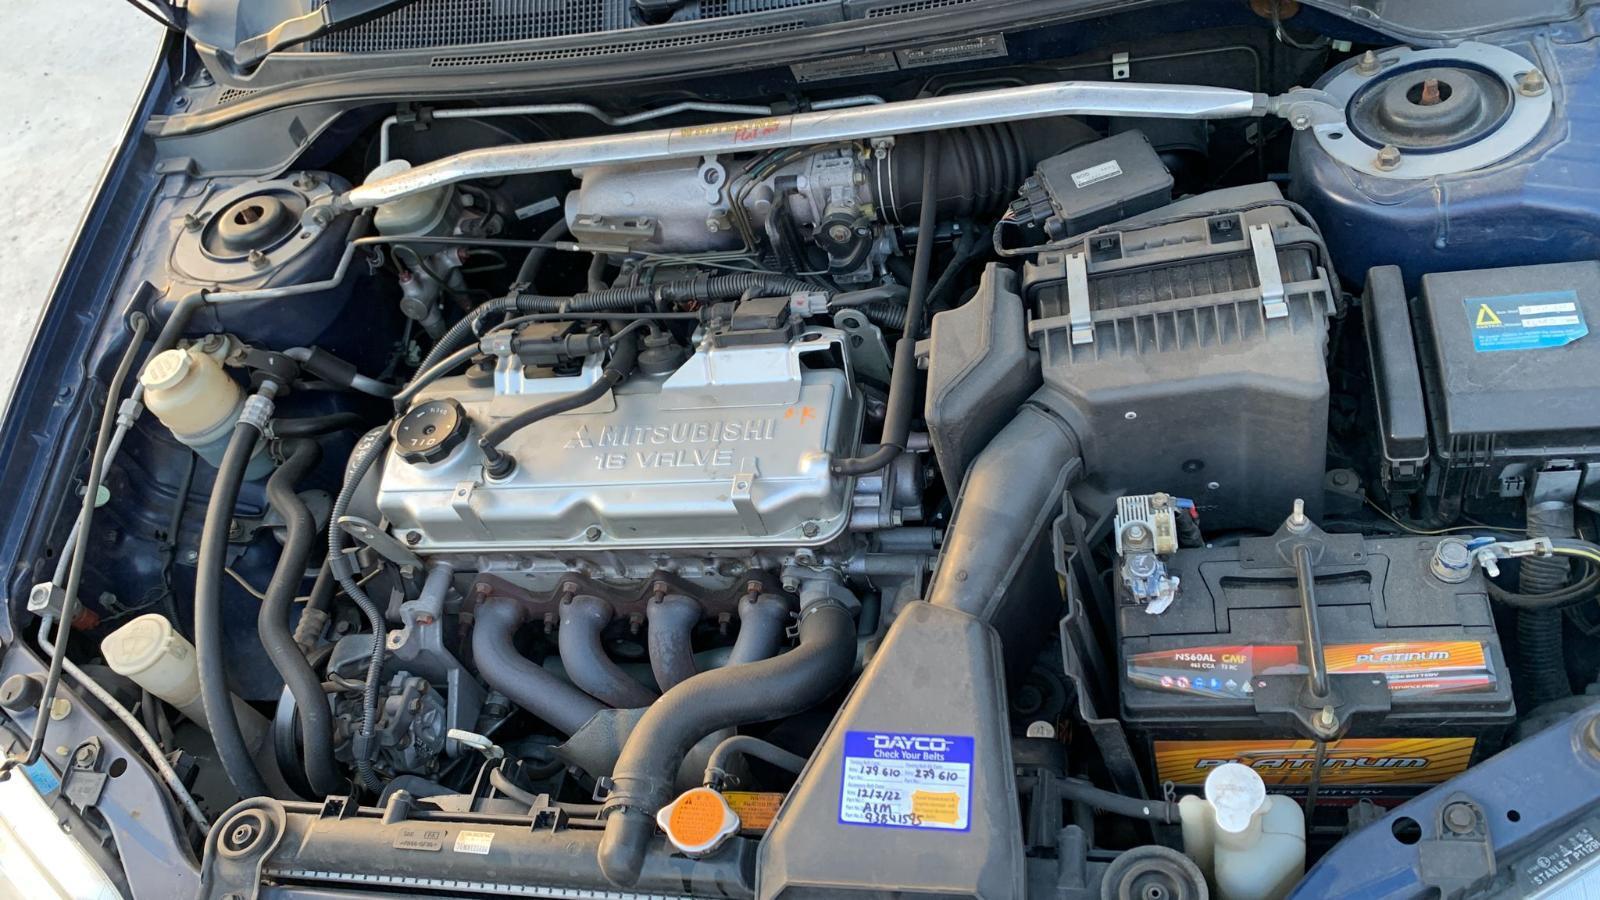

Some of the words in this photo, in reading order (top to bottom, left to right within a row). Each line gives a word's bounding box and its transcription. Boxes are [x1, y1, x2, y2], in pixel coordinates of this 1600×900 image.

[599, 418, 777, 446] MITSUBISHI
[595, 452, 628, 470] 16
[636, 449, 735, 468] VALVE
[1176, 653, 1216, 662] NS60AL
[1221, 654, 1247, 664] CMF
[1356, 651, 1449, 663] PLATINUM
[867, 735, 954, 752] DAYCO
[873, 749, 900, 759] Check
[902, 750, 921, 760] Your
[923, 751, 945, 761] Belts
[882, 767, 901, 778] 610
[914, 768, 935, 779] 279
[938, 771, 958, 781] 610
[1533, 857, 1572, 885] STANLEY
